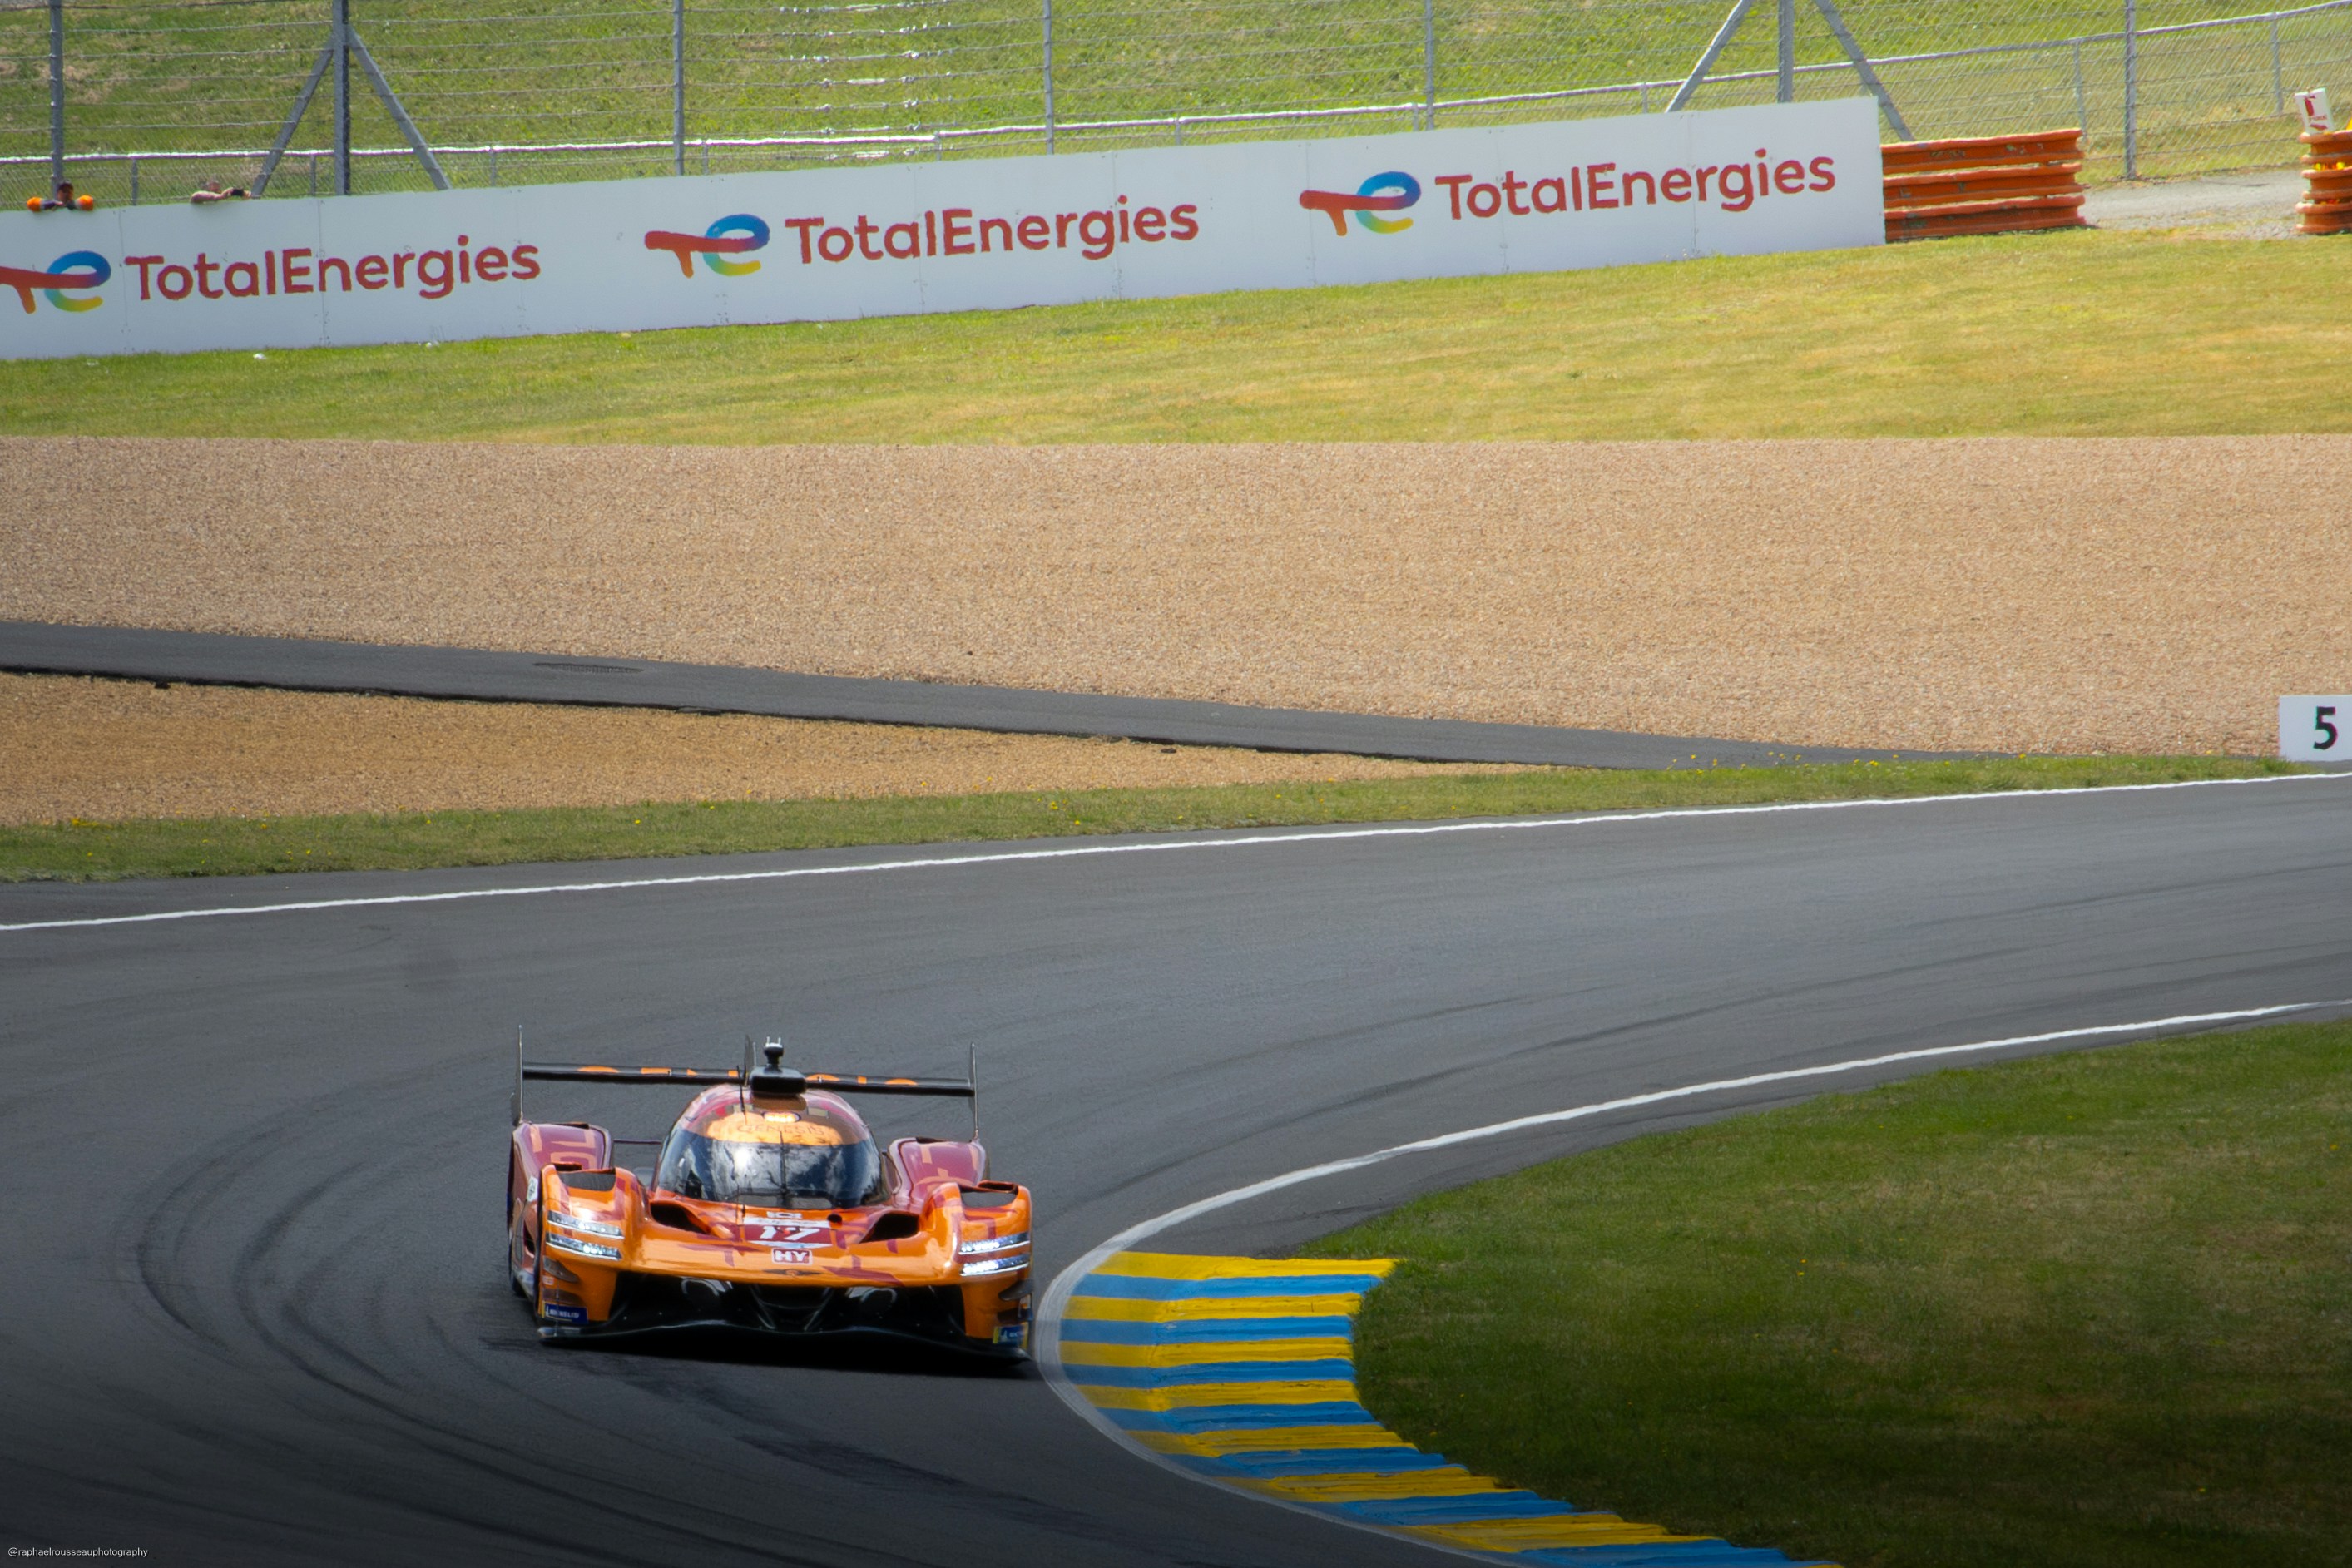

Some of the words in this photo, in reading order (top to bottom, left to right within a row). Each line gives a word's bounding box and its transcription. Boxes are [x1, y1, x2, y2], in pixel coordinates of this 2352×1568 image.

[1434, 148, 1835, 220] TotalEnergies
[785, 195, 1199, 264] TotalEnergies
[126, 235, 541, 300] TotalEnergies
[2313, 705, 2338, 750] 5
[736, 1124, 825, 1135] GENESIS
[760, 1225, 821, 1241] 17
[775, 1249, 808, 1262] HY
